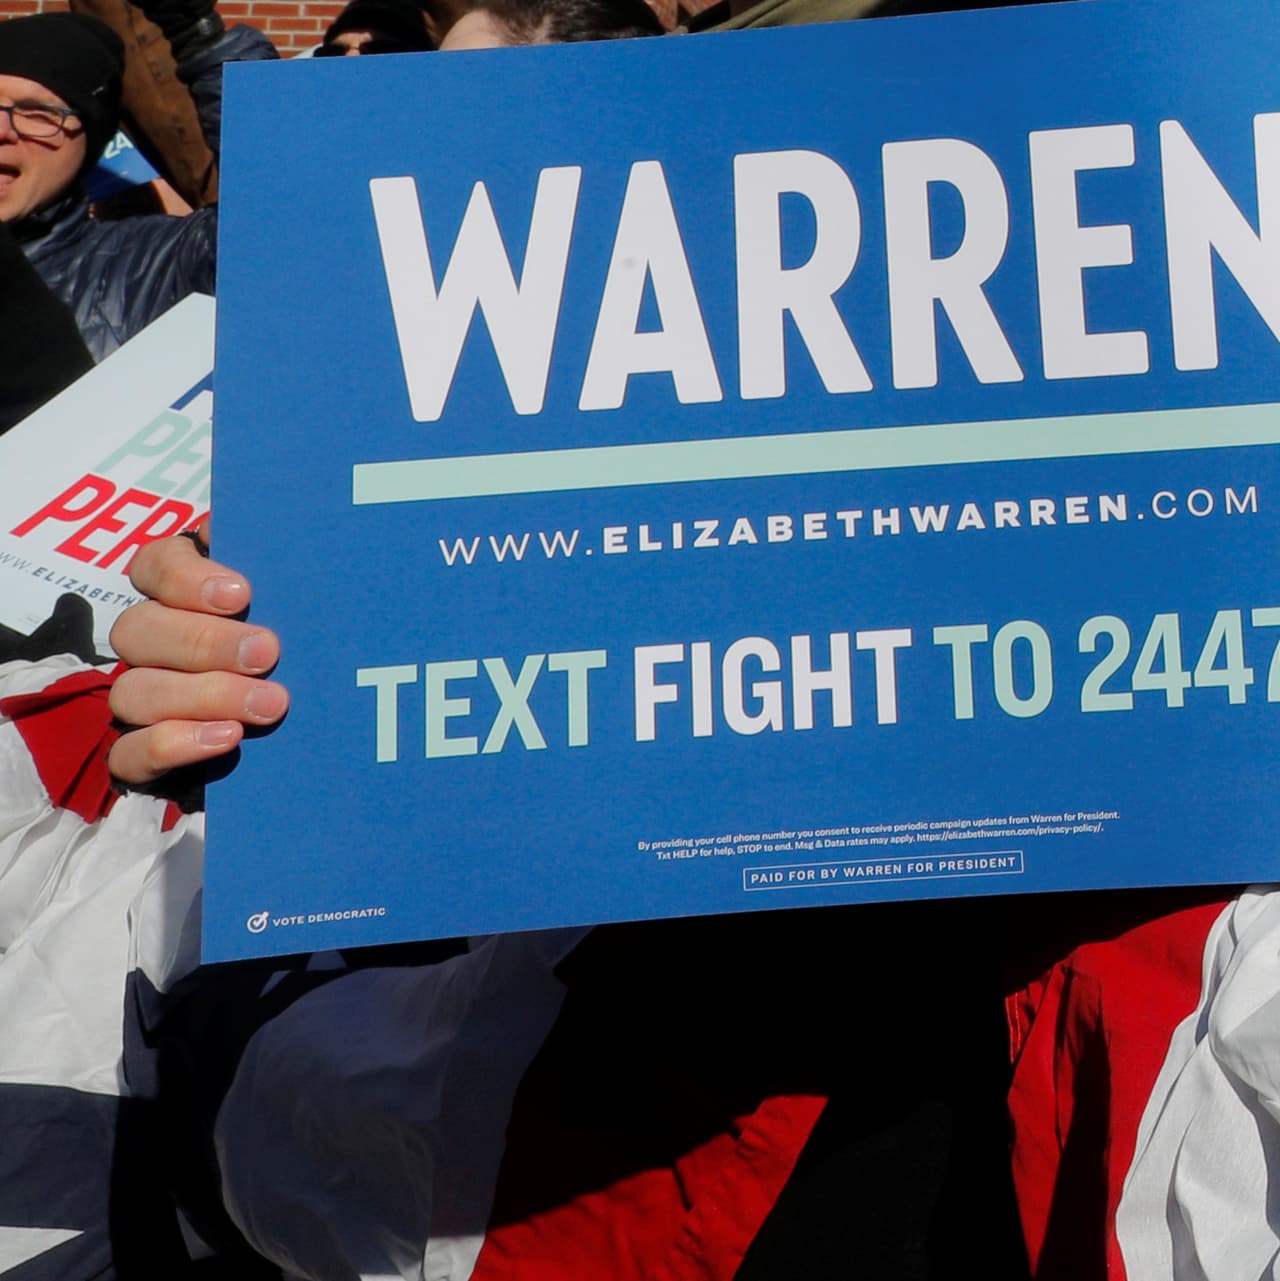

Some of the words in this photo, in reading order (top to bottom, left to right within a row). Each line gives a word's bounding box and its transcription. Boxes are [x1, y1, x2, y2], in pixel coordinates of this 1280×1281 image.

[439, 485, 1259, 567] WWW.ELIZABETHWARREN.COM
[357, 649, 607, 763] TEXT
[634, 628, 913, 742] FIGHT
[933, 620, 1053, 719] TO
[638, 841, 650, 851] By
[651, 837, 694, 850] providing
[694, 836, 714, 847] your
[716, 834, 732, 843] cell
[733, 832, 761, 844] phone
[762, 830, 795, 841] number
[797, 829, 813, 839] you
[814, 826, 850, 837] consent
[851, 826, 861, 834] to
[861, 824, 893, 833] receive
[894, 821, 929, 834] periodic
[930, 819, 972, 830] campaign
[972, 817, 1007, 828] updates
[1008, 815, 1029, 824] from
[1030, 814, 1063, 824] Warren
[1063, 813, 1076, 821] for
[1077, 811, 1121, 821] President.
[656, 851, 671, 861] Txt
[672, 849, 698, 860] HELP
[699, 848, 713, 858] for
[736, 844, 762, 854] STOP
[763, 844, 773, 852] to
[794, 841, 814, 851] Msg
[815, 839, 823, 848] &
[824, 838, 845, 848] Data
[846, 837, 869, 846] rates
[870, 836, 888, 847] may
[750, 872, 783, 884] PAID
[788, 870, 816, 881] FOR
[820, 868, 838, 879] BY
[843, 864, 902, 877] WARREN
[907, 862, 934, 873] FOR
[938, 857, 1016, 871] PRESIDENT
[272, 916, 305, 927] VOTE
[307, 907, 386, 924] DEMOCRATIC
